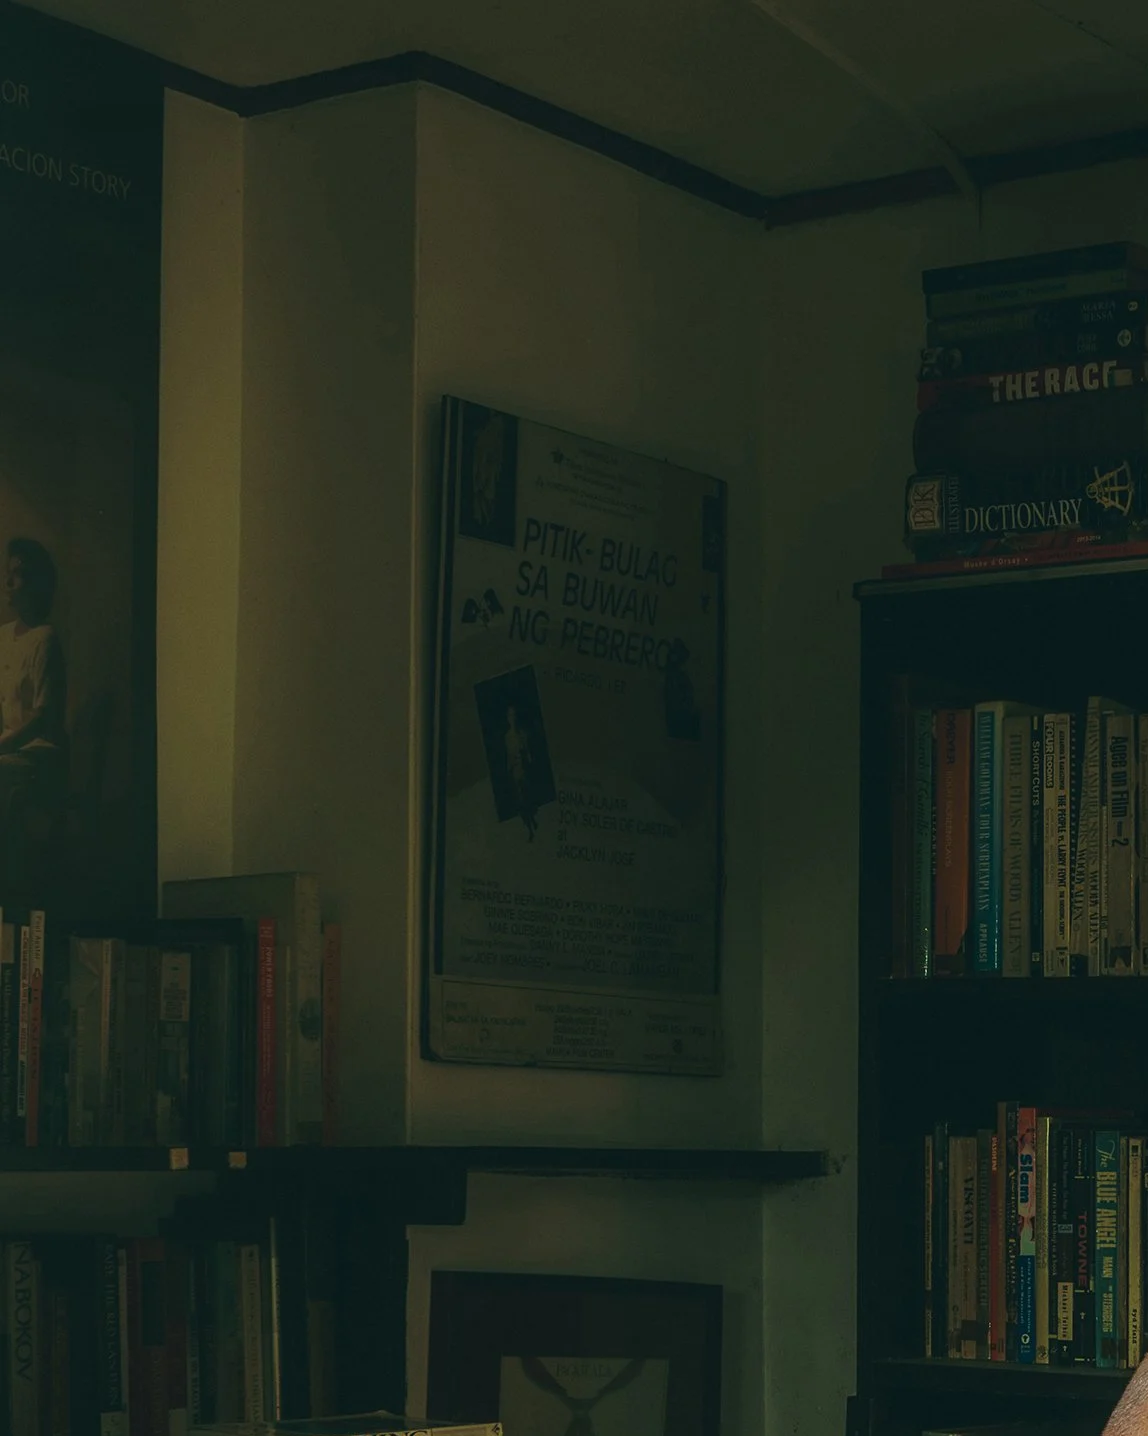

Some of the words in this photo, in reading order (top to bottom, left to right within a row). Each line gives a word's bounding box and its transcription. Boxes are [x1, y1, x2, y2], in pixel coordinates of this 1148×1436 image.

[70, 164, 131, 201] STORY
[988, 369, 1039, 403] THE
[963, 498, 1083, 534] DICTIONARY
[523, 518, 594, 564] PITIK-
[516, 561, 549, 600] SA
[562, 572, 658, 626] BUWAN
[509, 606, 550, 645] NG
[1109, 736, 1129, 768] Agee
[1113, 771, 1128, 787] on
[1111, 790, 1130, 818] Film
[1020, 1154, 1033, 1204] Slam
[1096, 1171, 1117, 1204] BLUE
[1096, 1208, 1117, 1250] ANGEL
[1077, 1211, 1088, 1288] TOWNE
